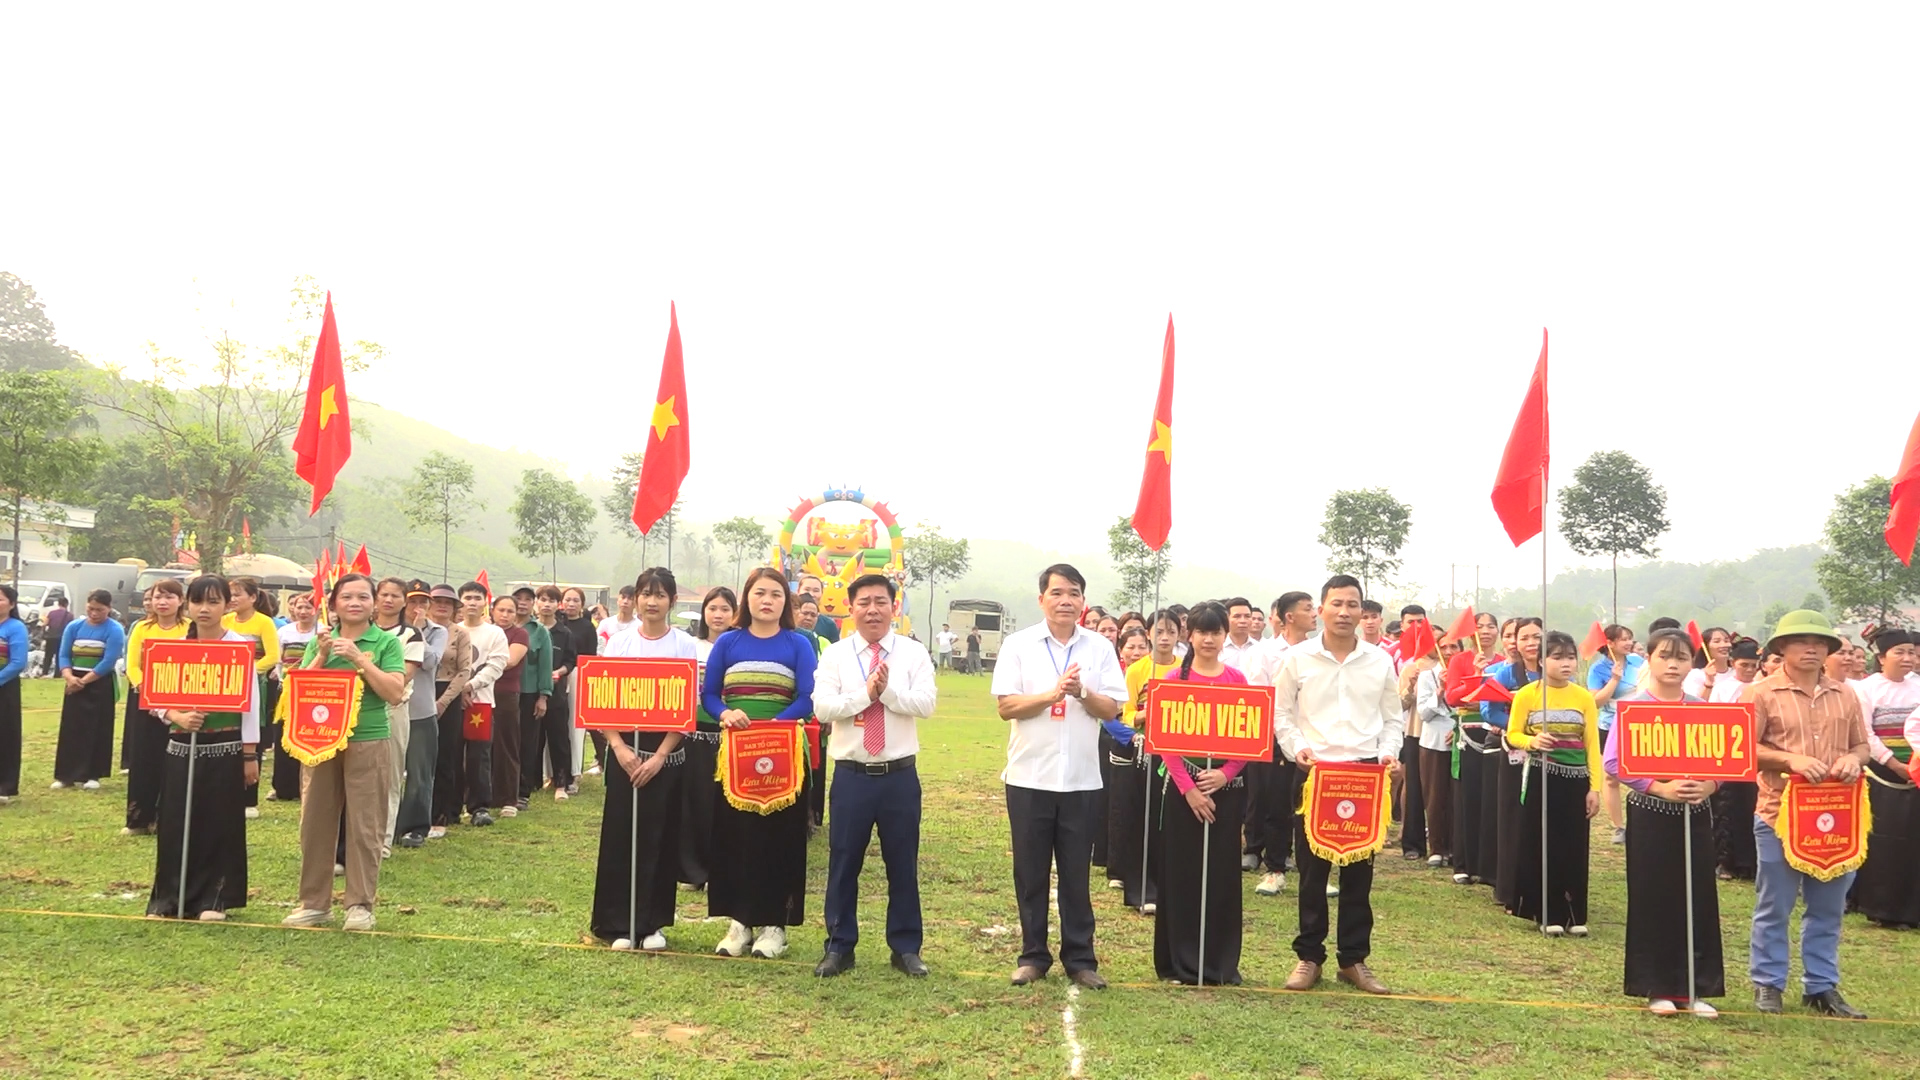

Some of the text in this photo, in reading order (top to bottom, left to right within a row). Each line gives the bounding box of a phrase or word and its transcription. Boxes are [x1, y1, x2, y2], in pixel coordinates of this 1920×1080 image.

[152, 656, 180, 694] THÔN
[587, 670, 617, 709] THÔN
[620, 677, 655, 717] NGHỊU
[1160, 694, 1261, 739] THÔN VIÊN
[1629, 715, 1744, 766] THÔN KHỤ 2
